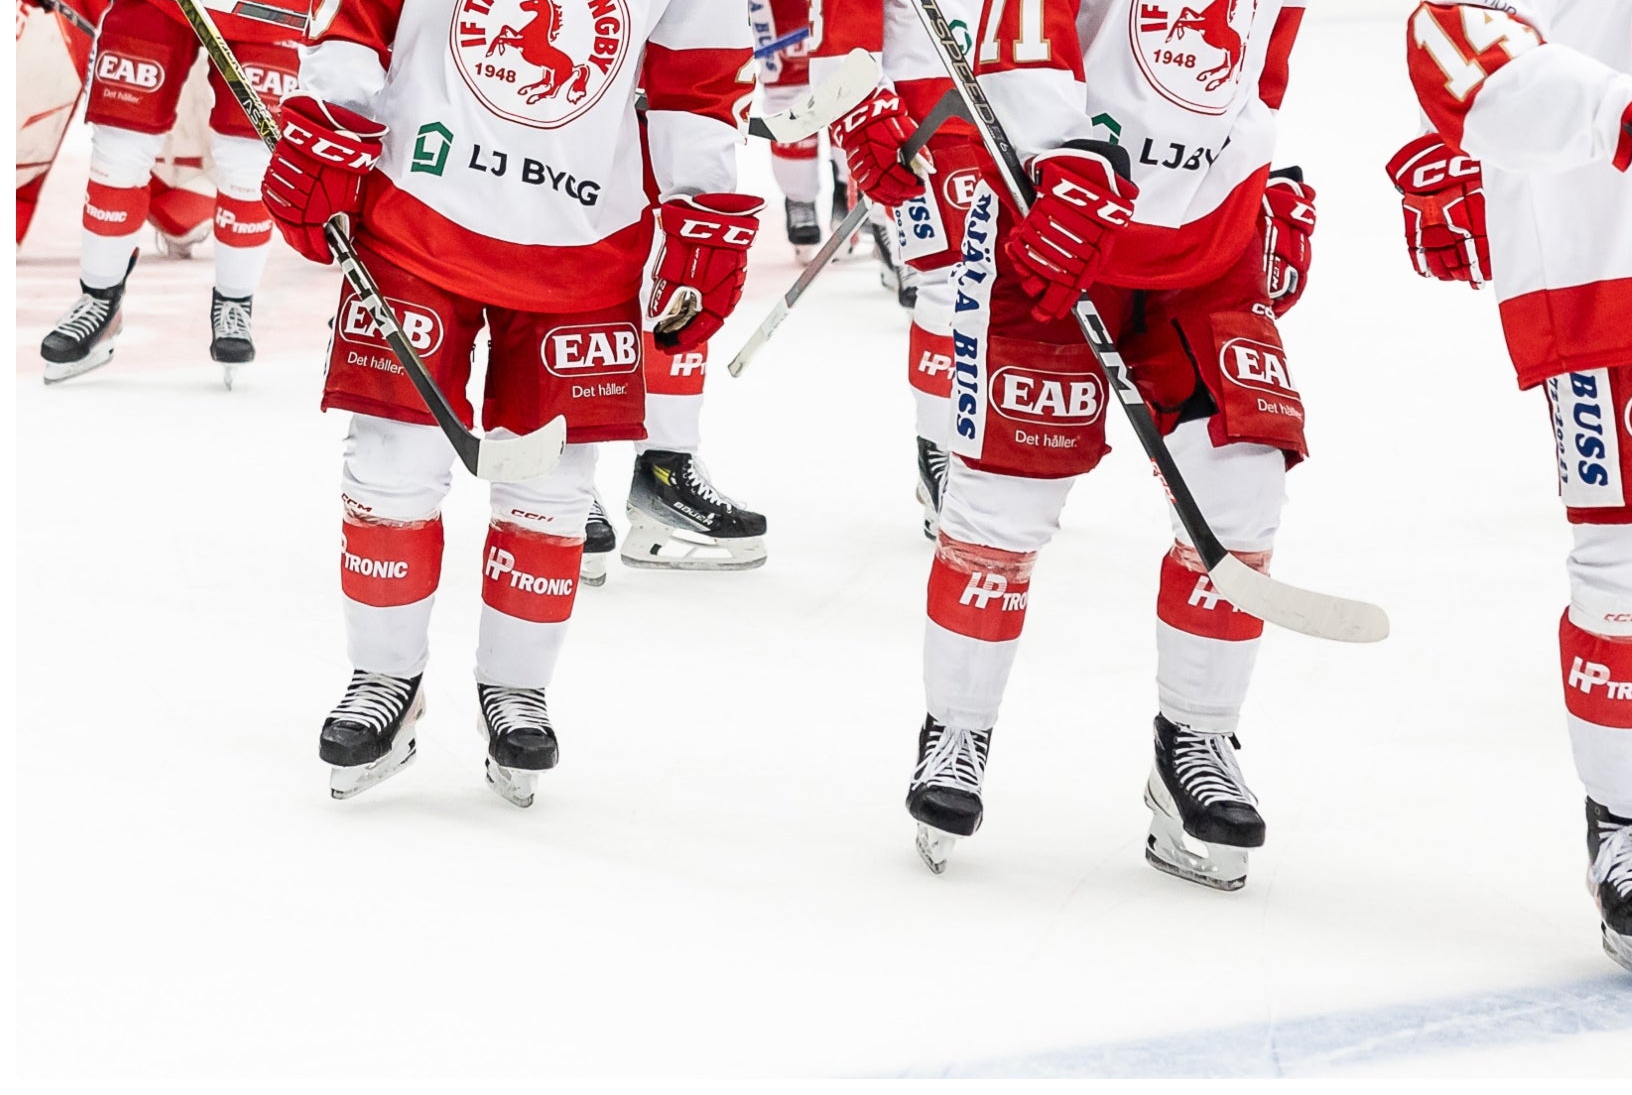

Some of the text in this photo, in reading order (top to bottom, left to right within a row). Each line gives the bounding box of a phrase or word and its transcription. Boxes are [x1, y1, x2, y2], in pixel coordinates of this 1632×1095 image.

[460, 21, 487, 48] IF
[1140, 3, 1169, 33] IF
[1153, 49, 1197, 69] 1948
[1412, 3, 1543, 104] 14
[100, 54, 159, 87] EAB
[474, 62, 517, 83] 1948
[281, 120, 383, 172] CCM
[468, 144, 508, 177] LJ
[1138, 137, 1186, 170] LJ
[1411, 155, 1481, 189] CC
[1051, 178, 1134, 227] CC
[679, 218, 755, 247] CC
[955, 193, 993, 314] MJÄLA
[344, 300, 434, 350] EB
[347, 351, 406, 377] Det håller.
[552, 330, 638, 371] EAB
[572, 381, 629, 399] Det håller.
[952, 328, 979, 441] BUSS
[1000, 373, 1098, 417] EAB
[1257, 398, 1279, 415] Det
[1015, 429, 1078, 449] Det håller.
[1569, 372, 1609, 487] BUSS
[484, 545, 574, 597] HPTRONIC
